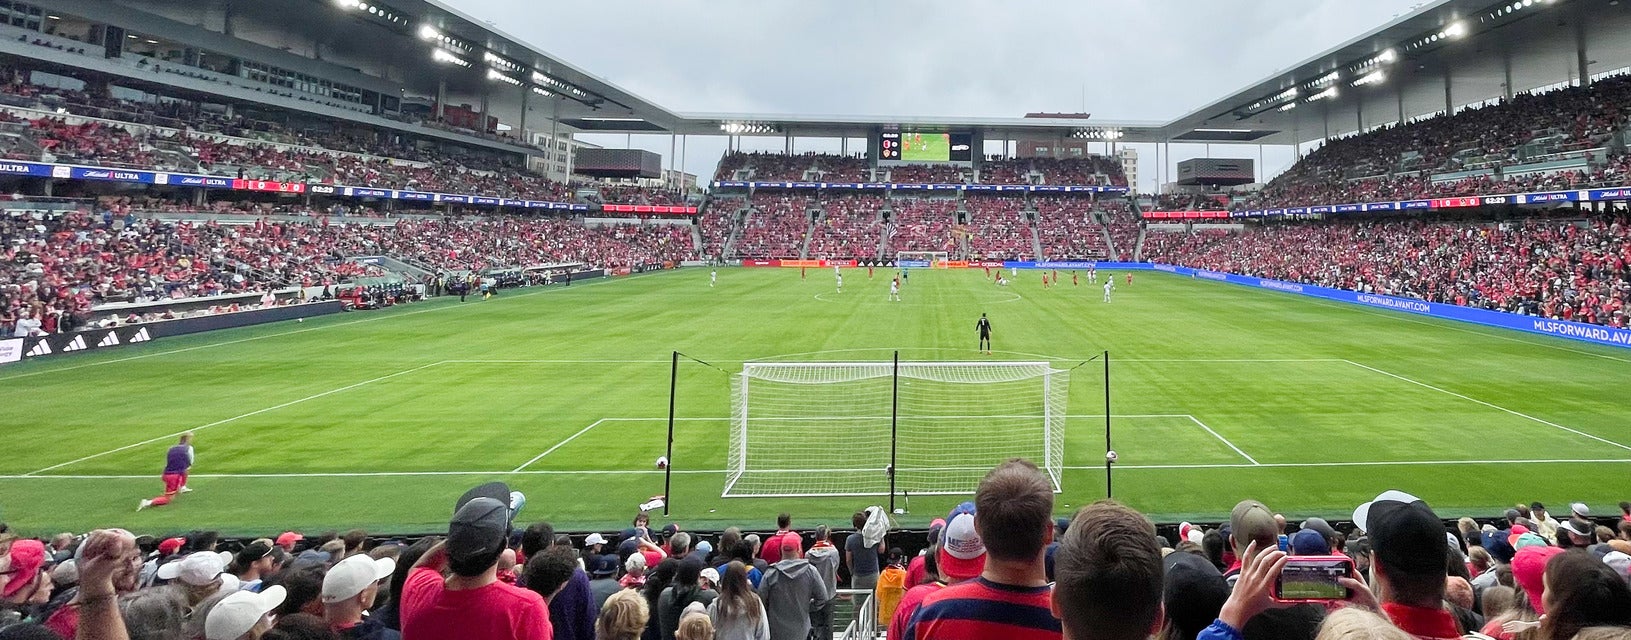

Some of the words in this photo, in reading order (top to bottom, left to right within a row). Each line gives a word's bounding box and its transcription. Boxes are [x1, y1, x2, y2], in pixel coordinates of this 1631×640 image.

[0, 164, 30, 173] ULTRA
[1485, 196, 1506, 204] 62:29
[1357, 295, 1430, 313] MLSFORWARD.AVANT.COM
